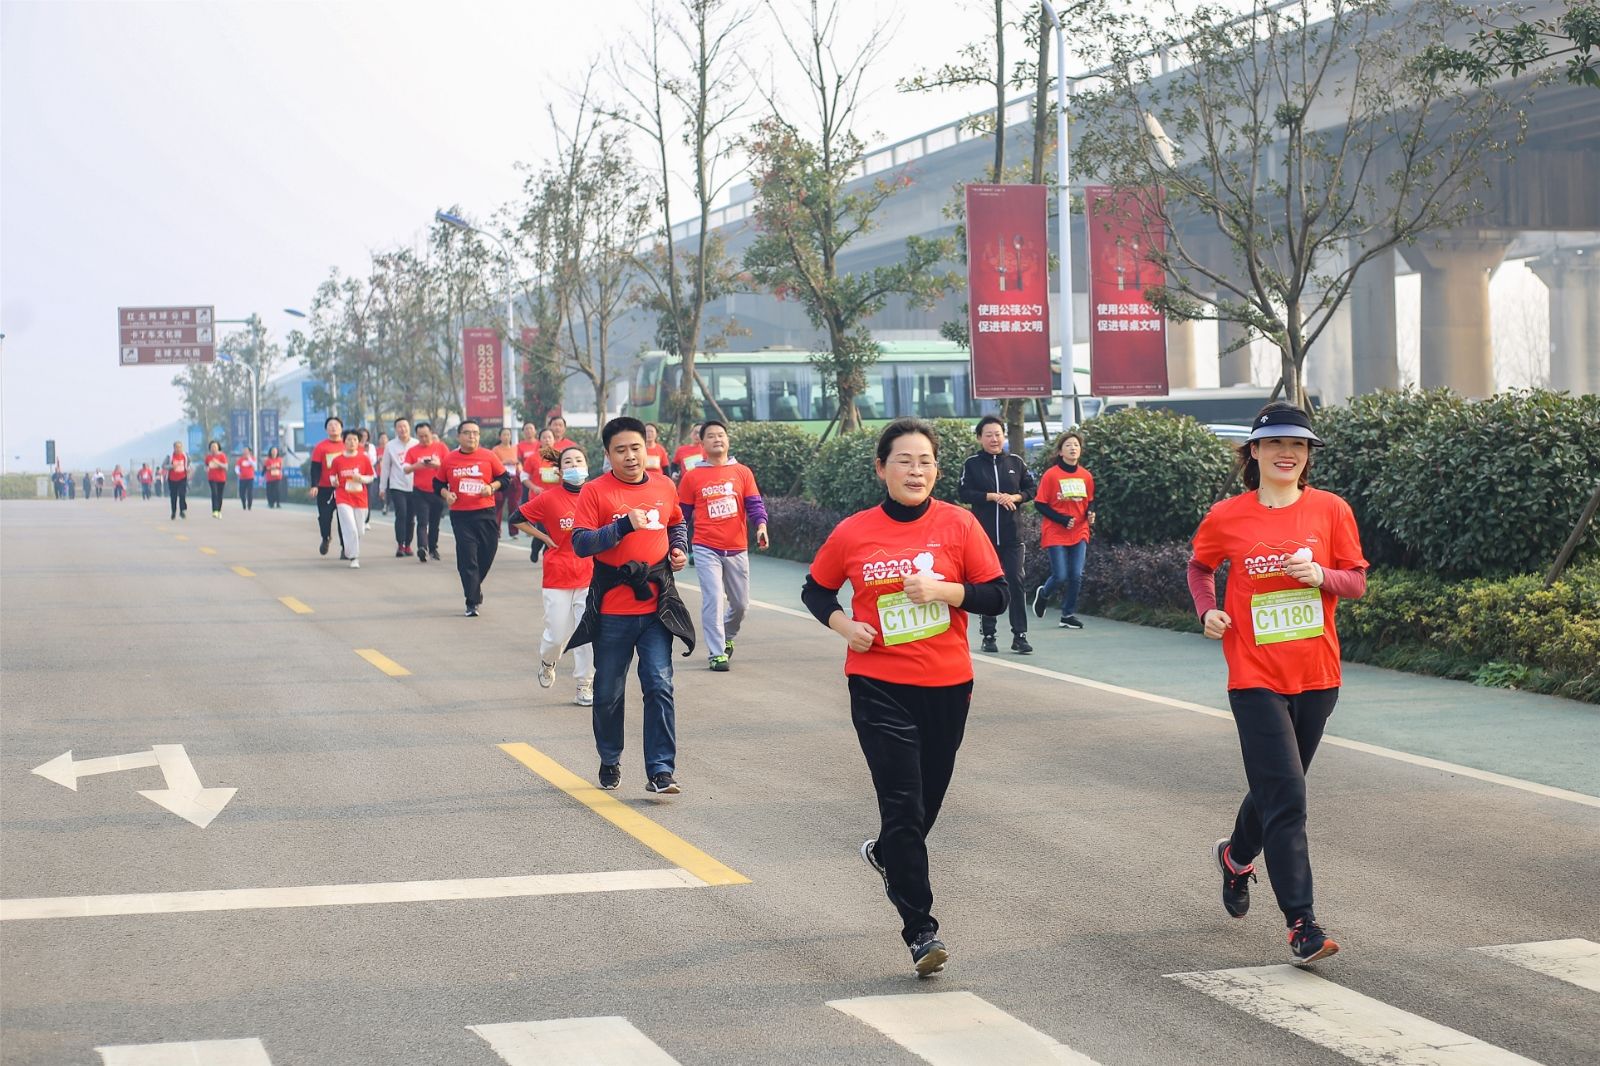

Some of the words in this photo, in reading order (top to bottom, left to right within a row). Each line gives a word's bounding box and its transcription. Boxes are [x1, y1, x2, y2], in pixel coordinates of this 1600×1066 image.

[978, 304, 1042, 316] 使用公筷公勺
[978, 321, 1043, 332] 促进餐桌文明
[1097, 320, 1160, 332] 促进餐桌文明
[477, 344, 493, 356] 83
[478, 357, 494, 368] 23
[478, 369, 494, 380] 53
[479, 381, 495, 393] 83
[702, 484, 725, 497] 2020
[862, 558, 913, 581] 2020
[883, 602, 941, 631] C1170
[1255, 604, 1315, 630] C1180
